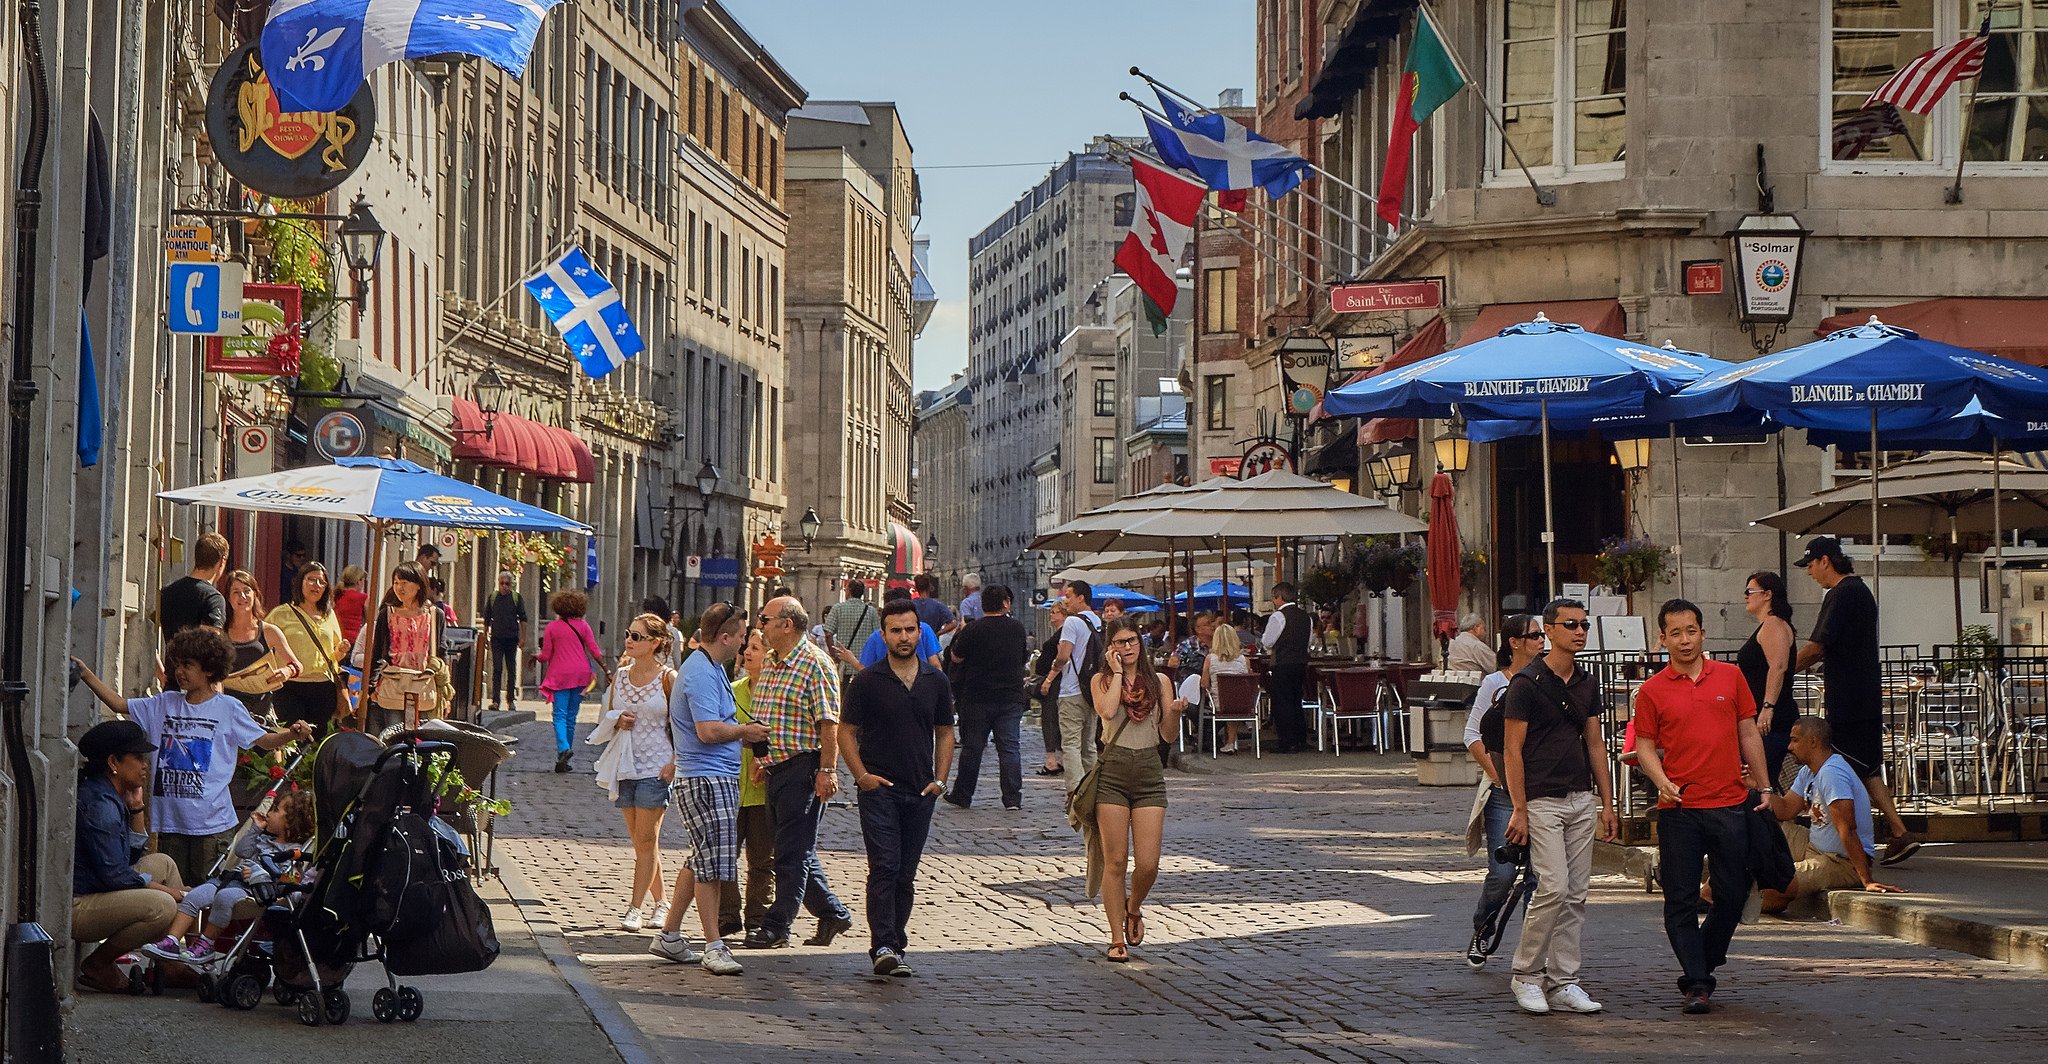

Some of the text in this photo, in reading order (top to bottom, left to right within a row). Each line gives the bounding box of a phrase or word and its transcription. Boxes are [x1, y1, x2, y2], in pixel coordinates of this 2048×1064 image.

[279, 125, 302, 133] RESTO
[1752, 242, 1795, 253] Solmar
[175, 251, 189, 259] ATM
[1346, 293, 1426, 308] Saint-Vincent
[221, 310, 240, 319] Bell
[1282, 351, 1329, 369] SOLMAR
[1464, 379, 1524, 397] BLANCHE
[1536, 377, 1591, 394] CHAMBLY
[1791, 385, 1854, 403] BLANCHE
[1867, 383, 1925, 401] CHAMBLY
[237, 488, 346, 505] Corona
[449, 512, 499, 522] Extra
